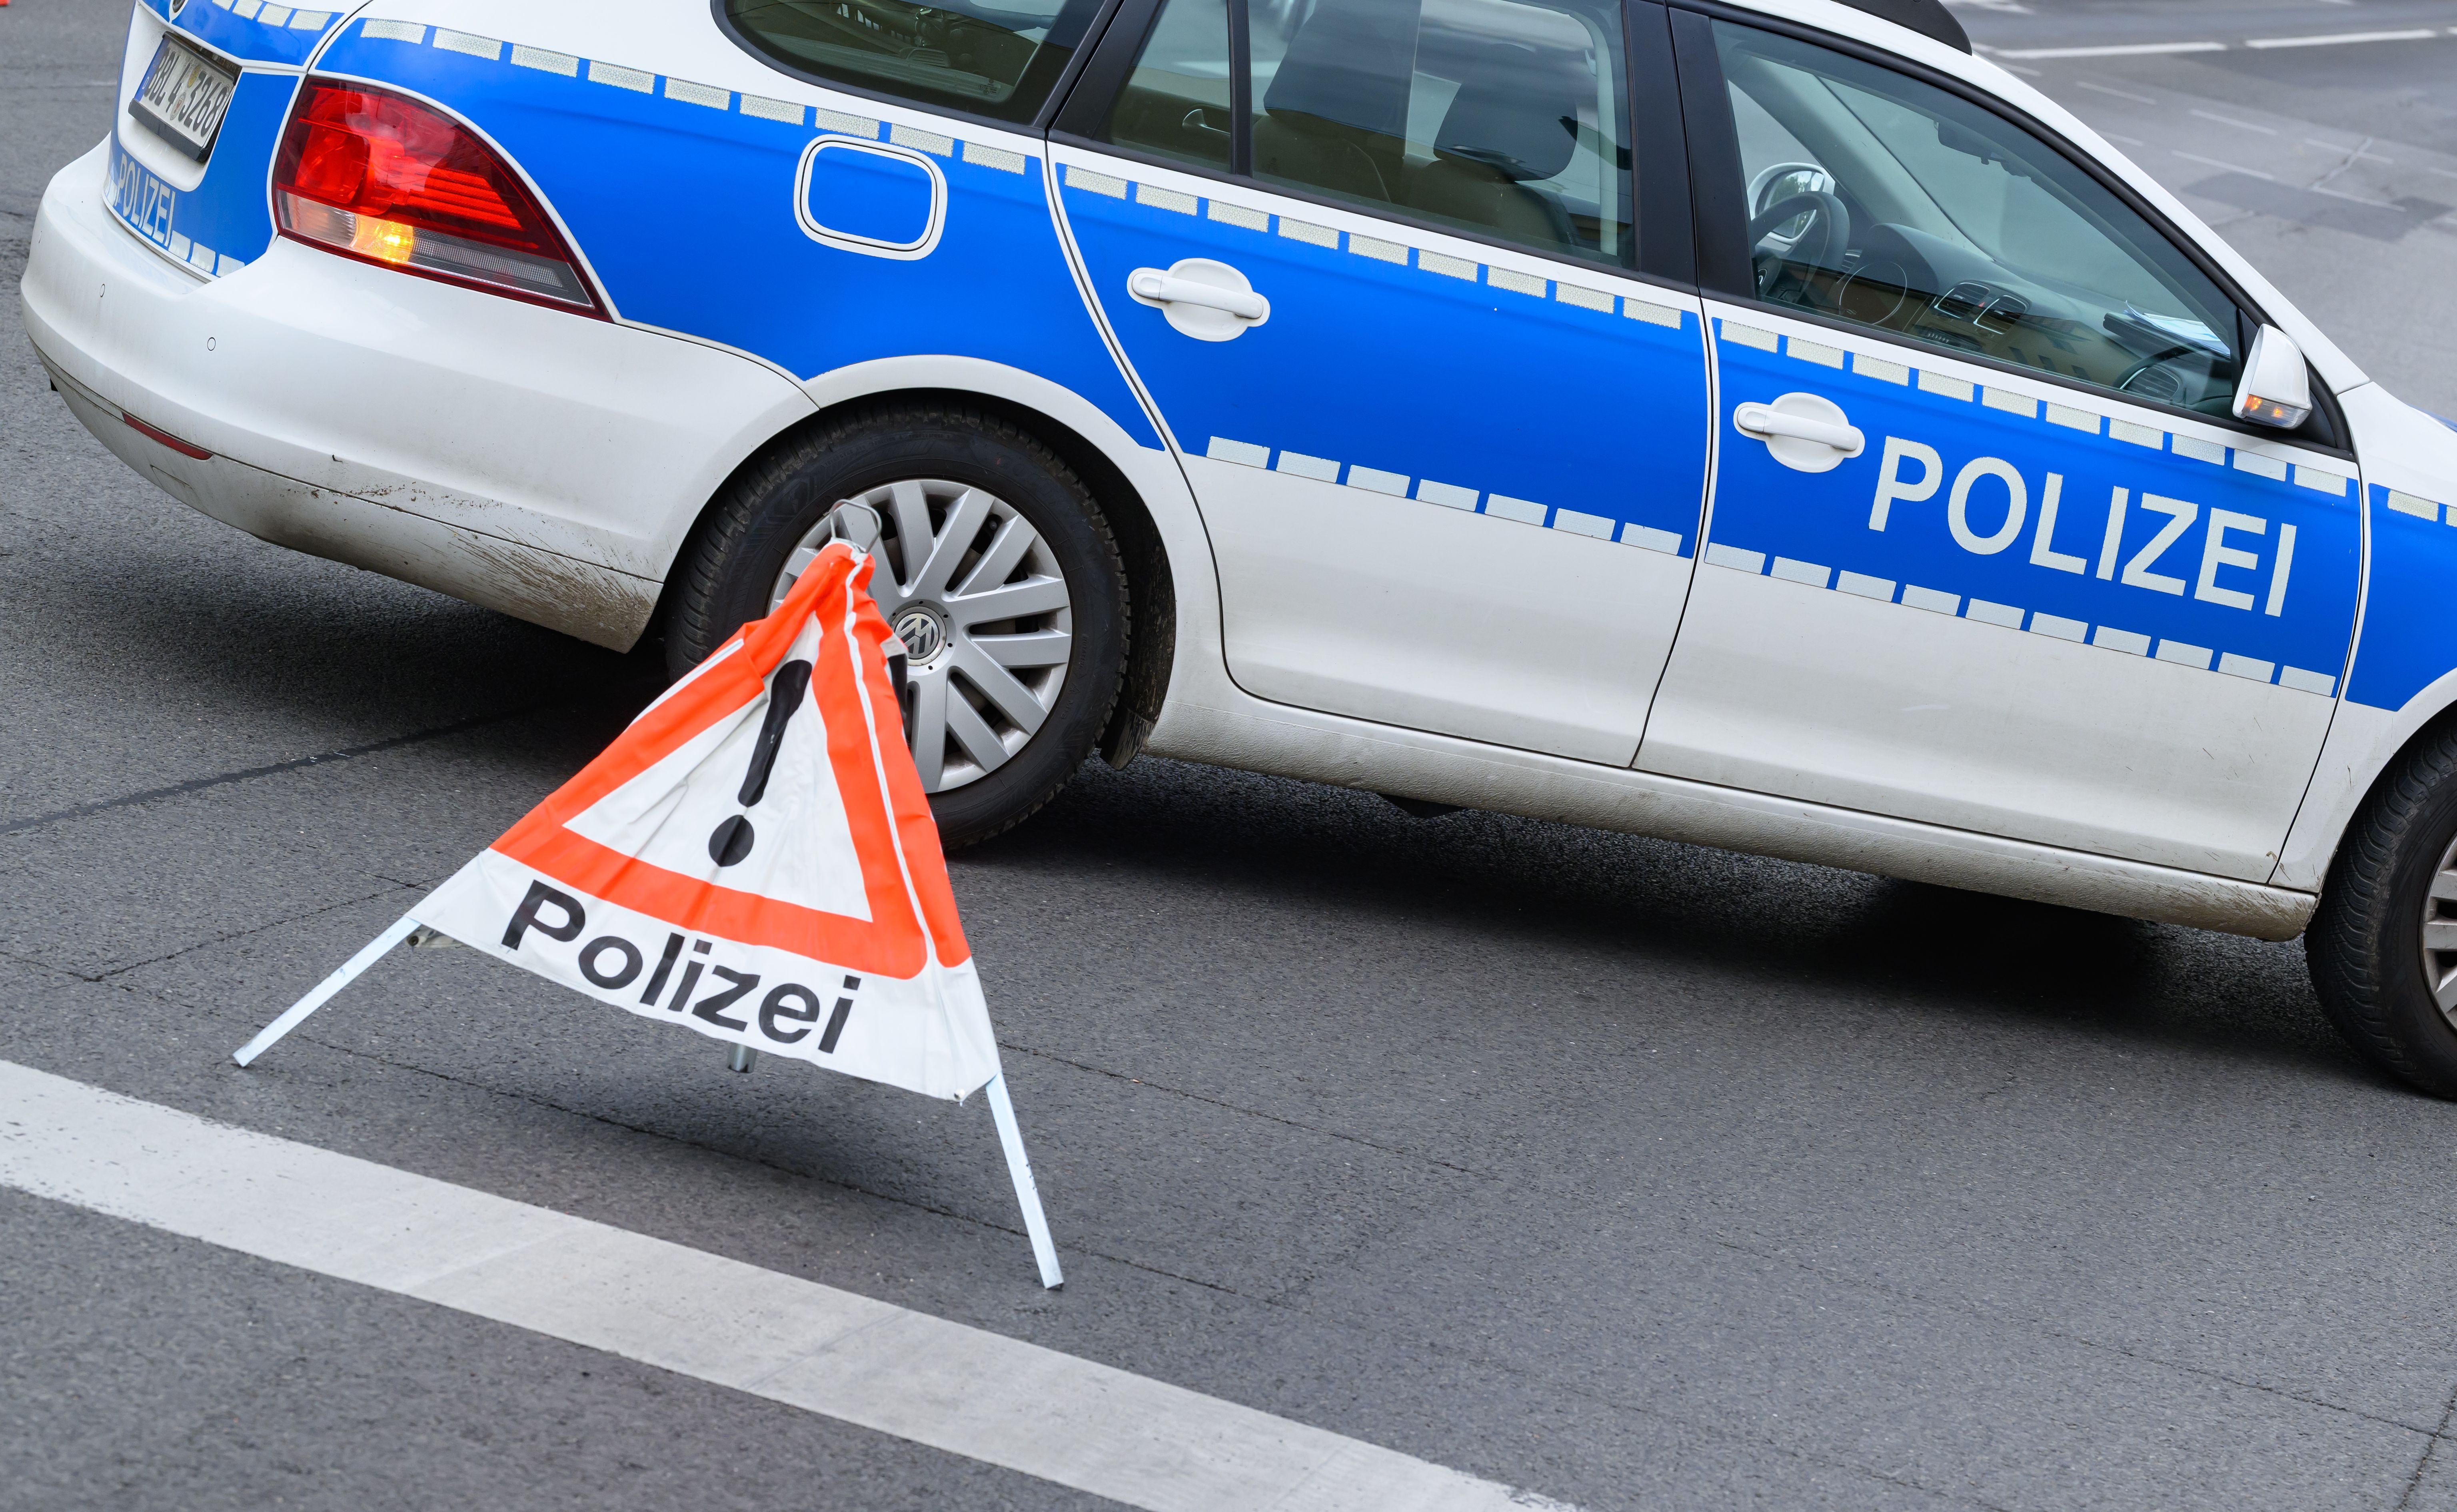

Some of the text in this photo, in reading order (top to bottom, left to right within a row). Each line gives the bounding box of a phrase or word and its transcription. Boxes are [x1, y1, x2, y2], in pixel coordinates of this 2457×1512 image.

[166, 63, 190, 113] 4
[178, 70, 229, 137] 3268
[117, 153, 176, 247] POLIZEI
[1868, 435, 2297, 617] POLIZEI
[501, 879, 861, 1053] Polizei
